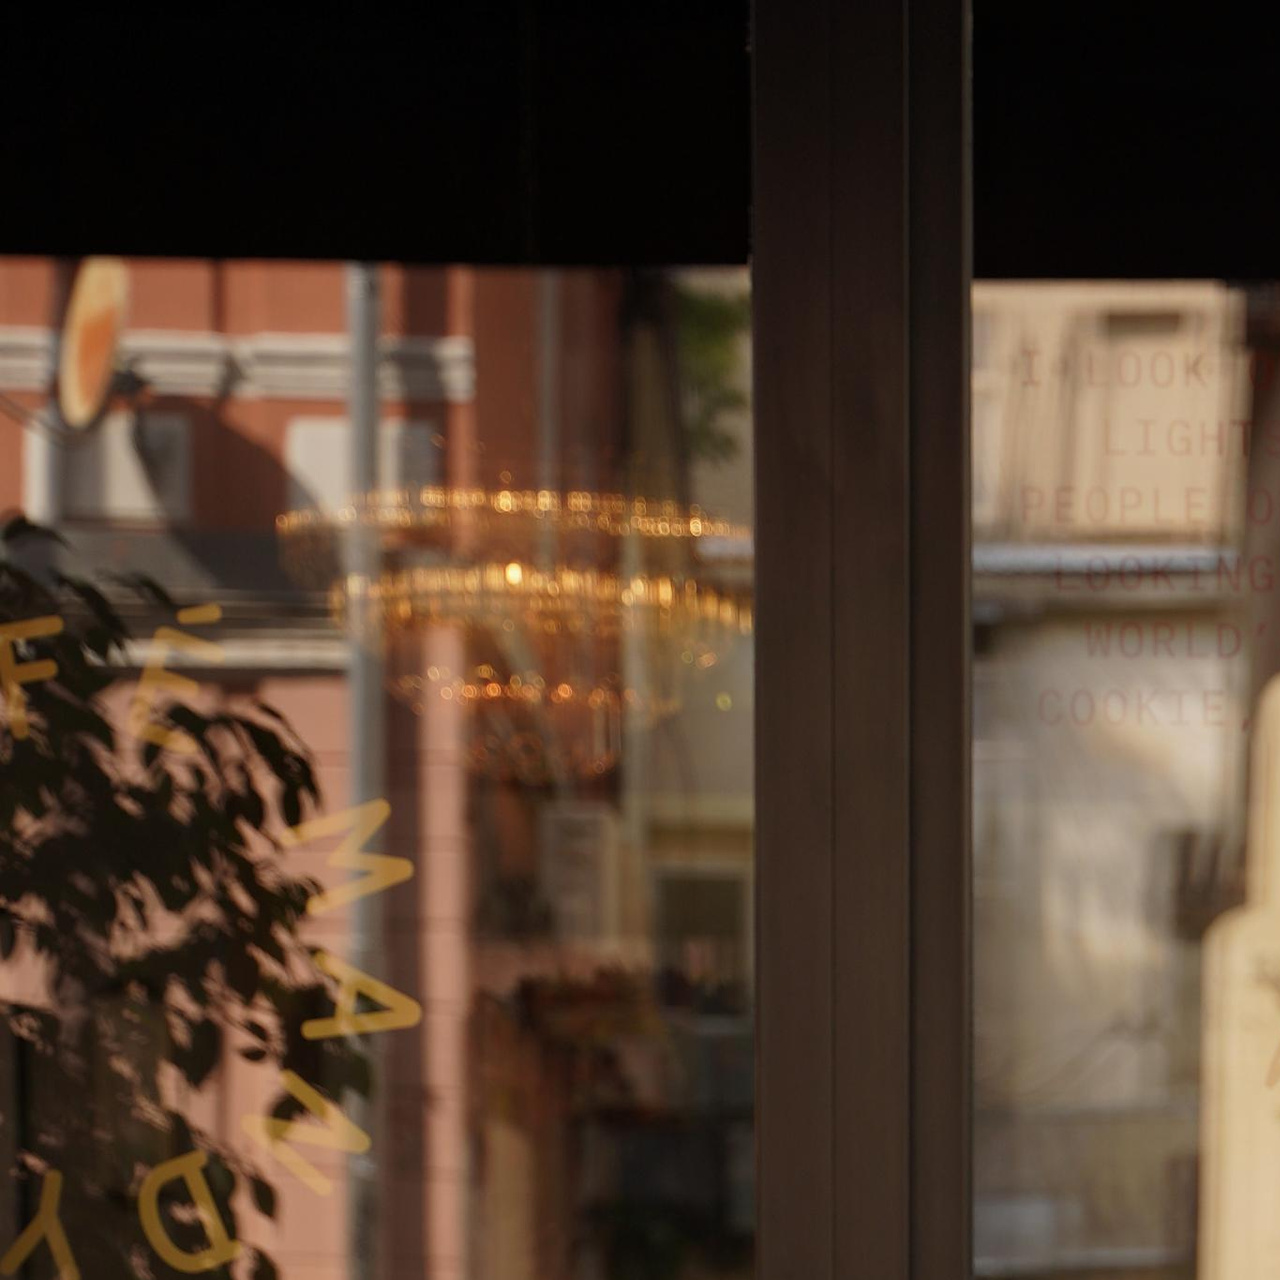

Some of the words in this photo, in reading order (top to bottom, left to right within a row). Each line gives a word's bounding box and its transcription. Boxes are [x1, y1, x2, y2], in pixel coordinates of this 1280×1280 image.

[1083, 350, 1208, 390] LOOK
[1019, 486, 1202, 525] PEOPLE
[1054, 556, 1276, 594] LOOKING
